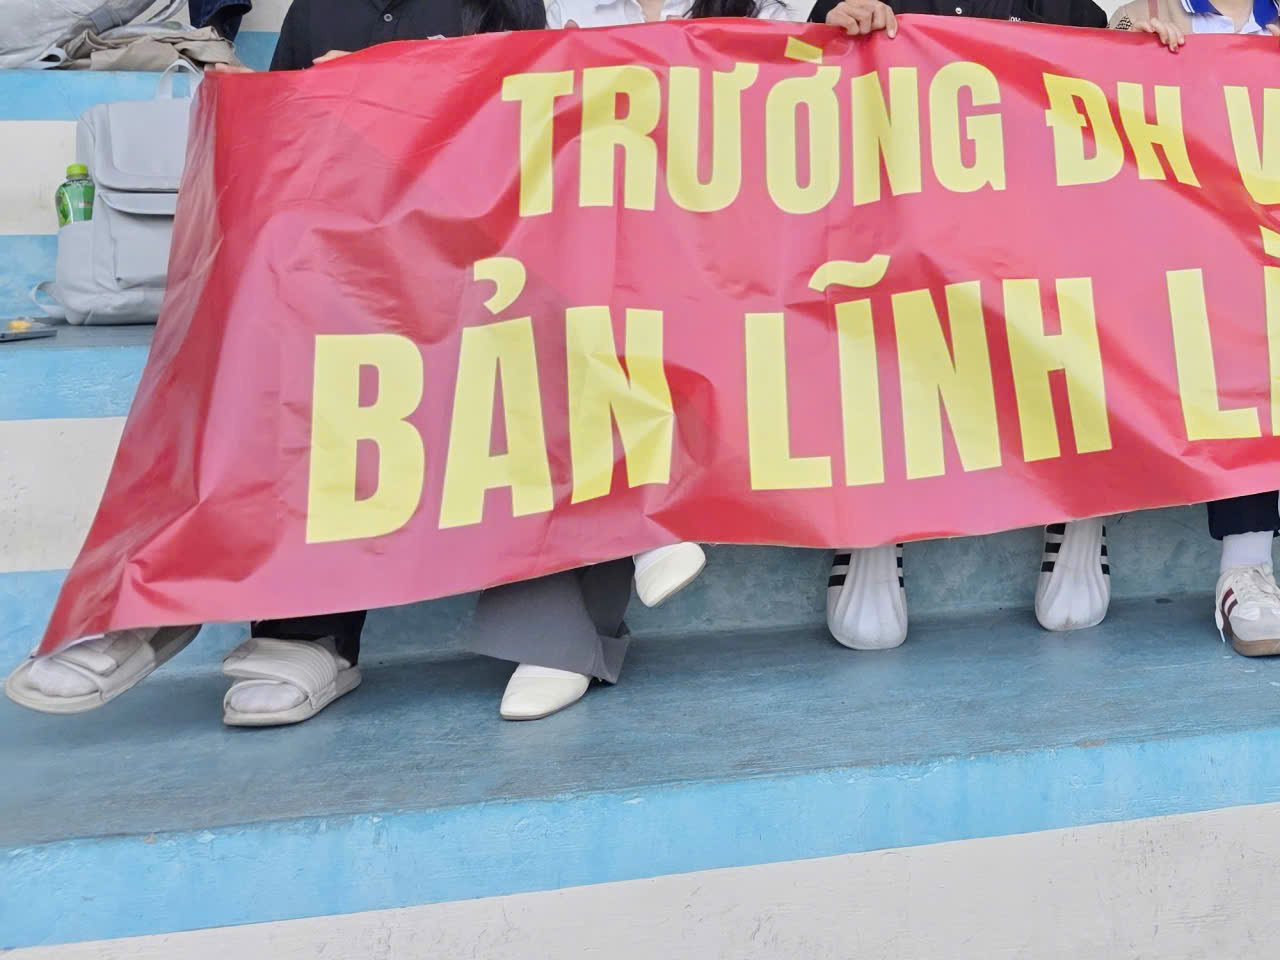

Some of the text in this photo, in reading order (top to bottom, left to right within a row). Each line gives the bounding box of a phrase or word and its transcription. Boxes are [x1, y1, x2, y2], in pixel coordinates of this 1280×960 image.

[501, 36, 1006, 215] TRƯỜNG
[1043, 72, 1201, 188] ĐH
[306, 256, 676, 544] BẢN
[745, 253, 1113, 492] LĨNH
